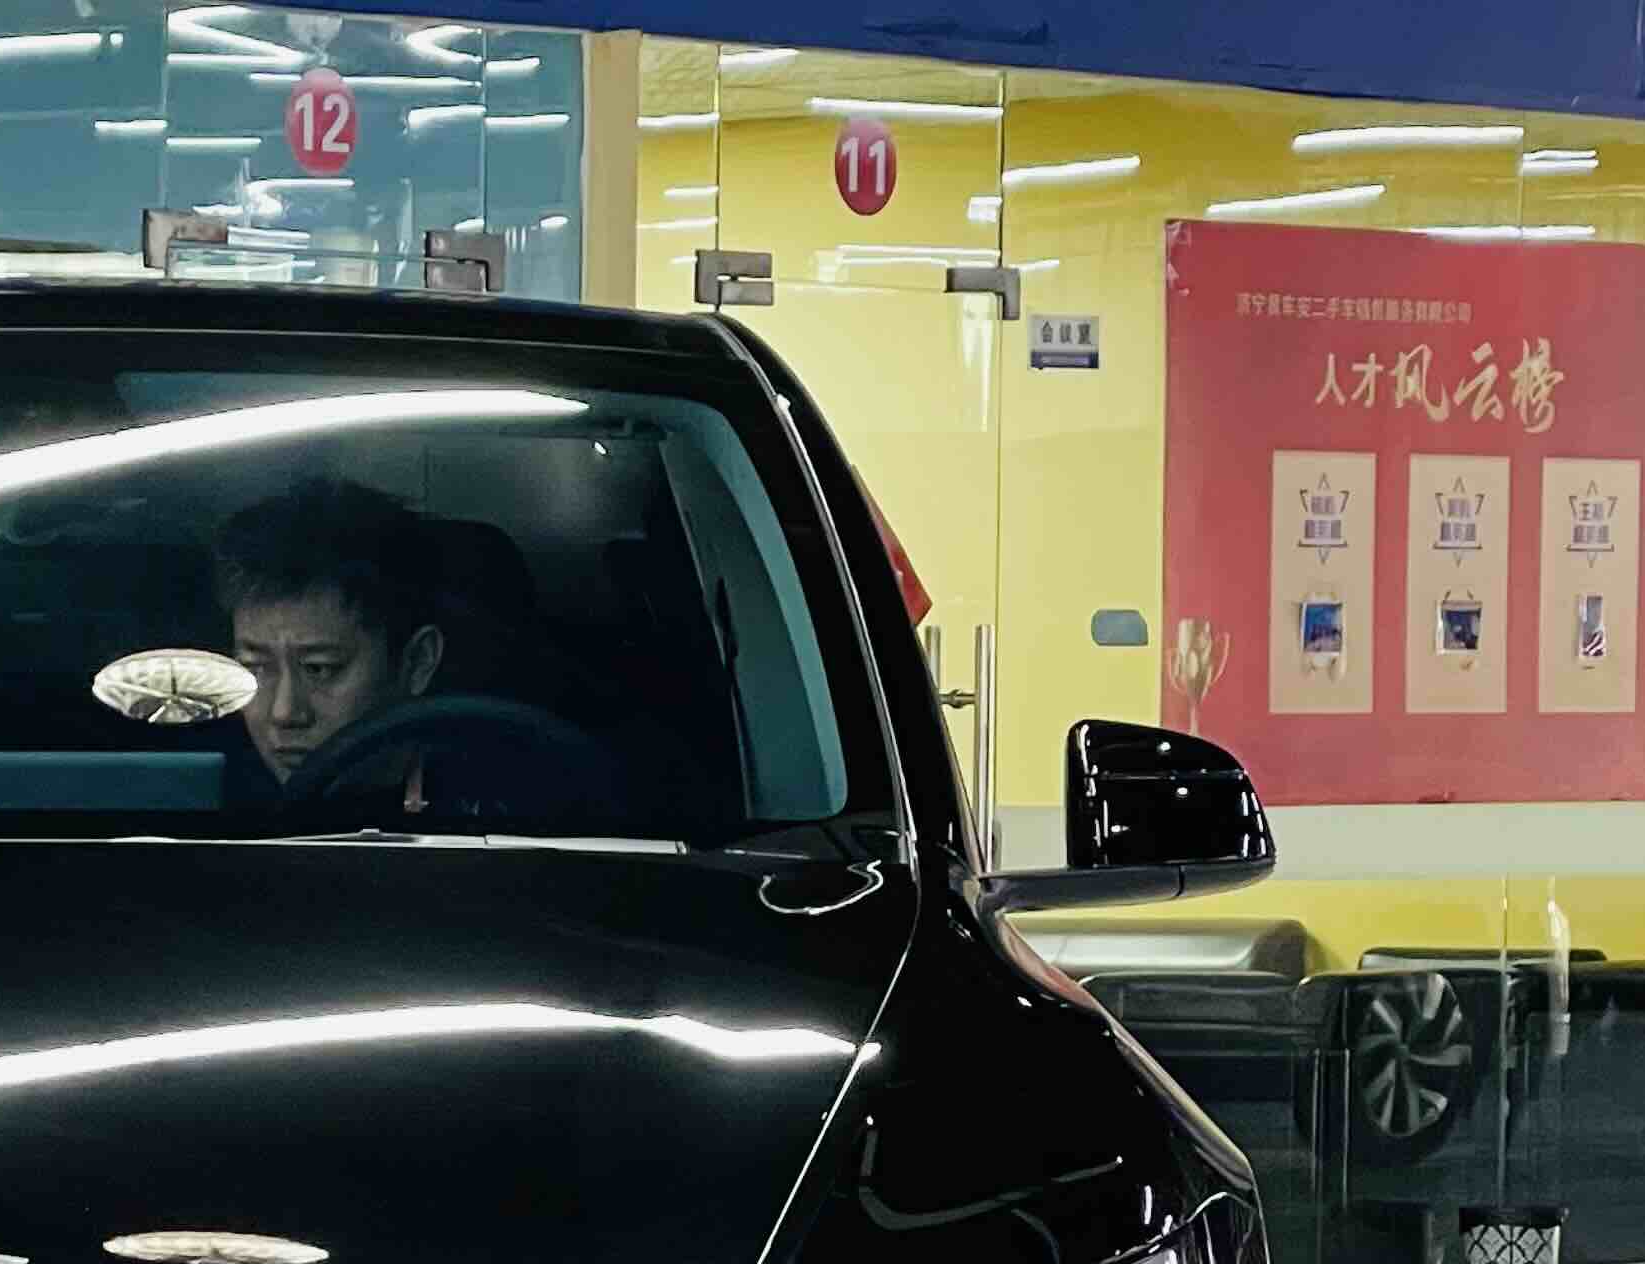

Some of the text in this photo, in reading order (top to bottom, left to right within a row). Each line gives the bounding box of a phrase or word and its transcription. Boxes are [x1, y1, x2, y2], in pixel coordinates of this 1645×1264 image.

[294, 93, 350, 153] 12
[840, 136, 886, 195] 11
[1314, 336, 1565, 434] 人才风云榜
